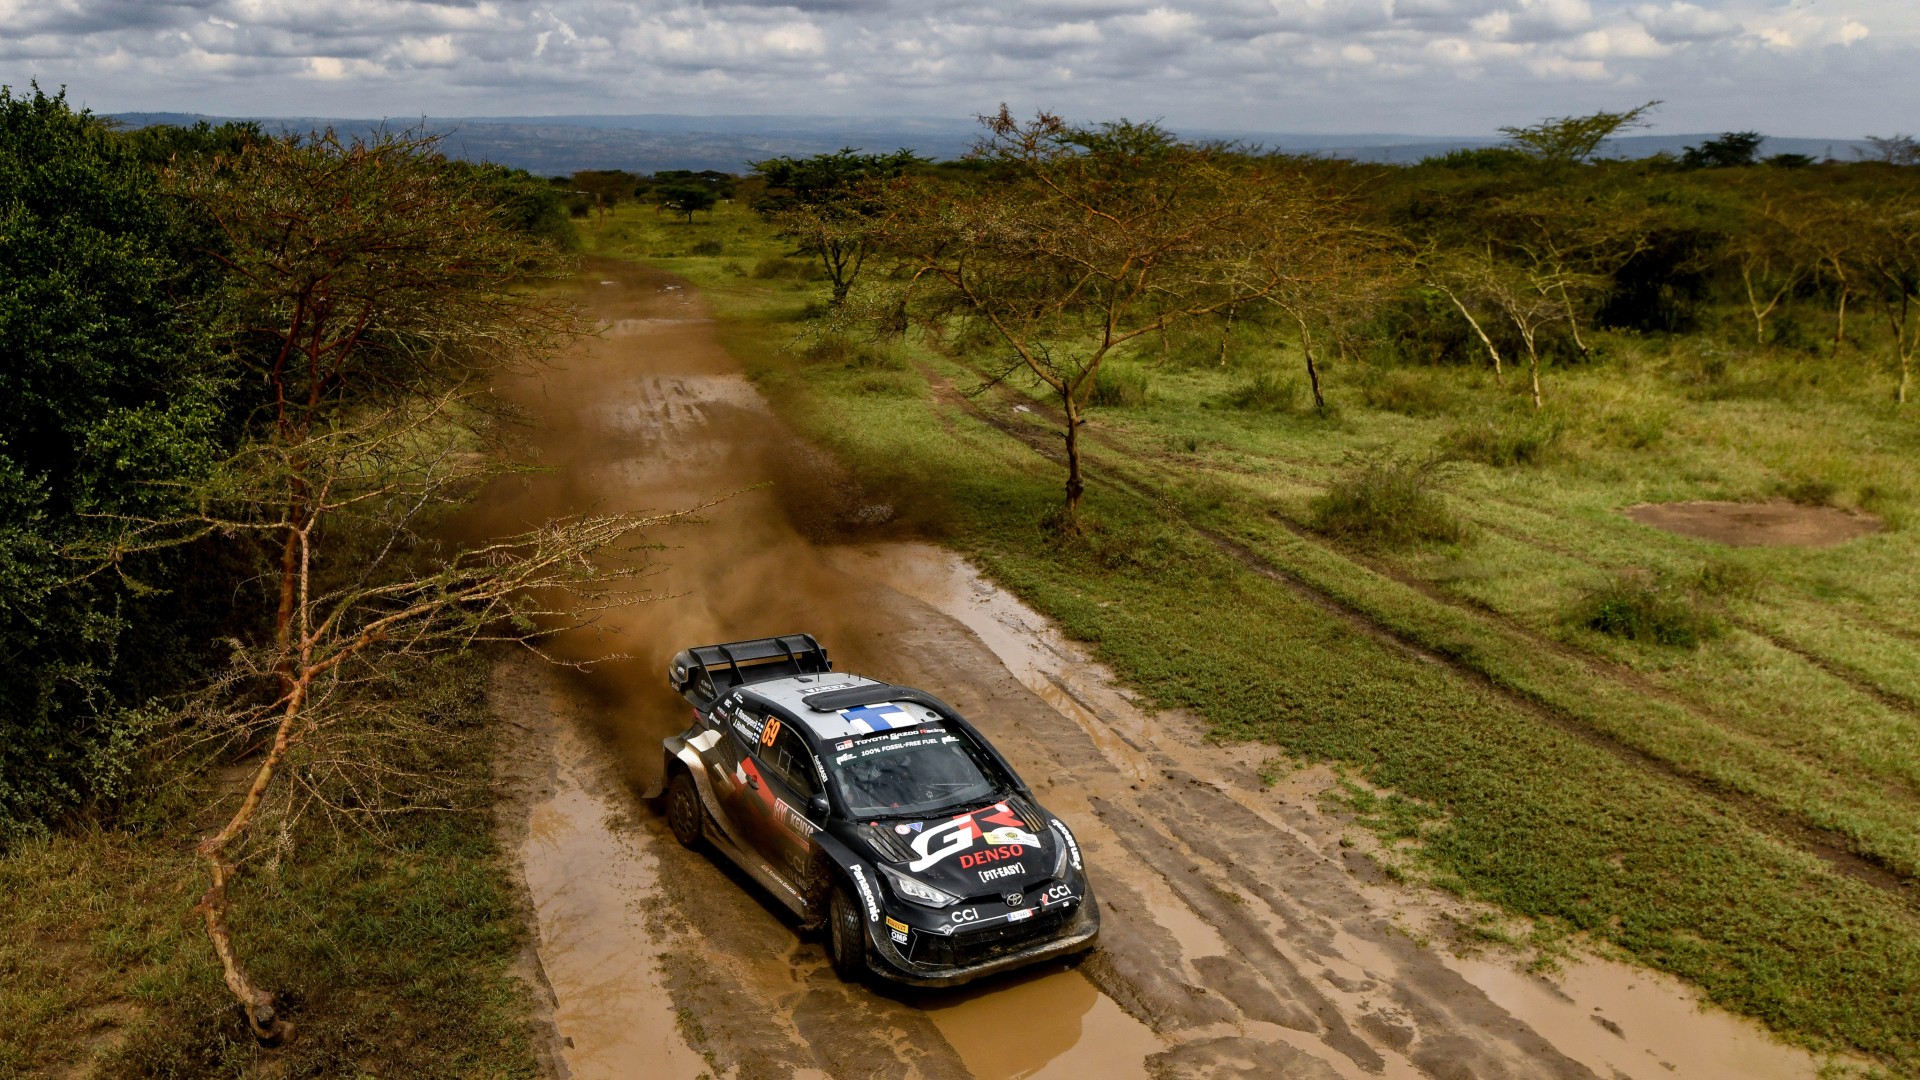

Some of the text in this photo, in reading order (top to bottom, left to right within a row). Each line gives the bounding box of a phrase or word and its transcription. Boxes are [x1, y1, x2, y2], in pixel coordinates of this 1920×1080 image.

[762, 718, 780, 747] 69
[855, 735, 889, 746] TOYOTA
[890, 729, 919, 739] GAZOO
[920, 727, 947, 735] Racing
[861, 747, 881, 757] 100%
[882, 740, 922, 752] FOSSIL-FREE
[909, 800, 1025, 872] GR
[1050, 818, 1082, 871] Panasonic
[959, 844, 1023, 869] DENSO
[849, 864, 880, 922] Panasonic
[1048, 884, 1072, 899] CCI
[887, 917, 906, 932] PIRELLI
[951, 907, 979, 923] CCI
[891, 931, 908, 942] OMP
